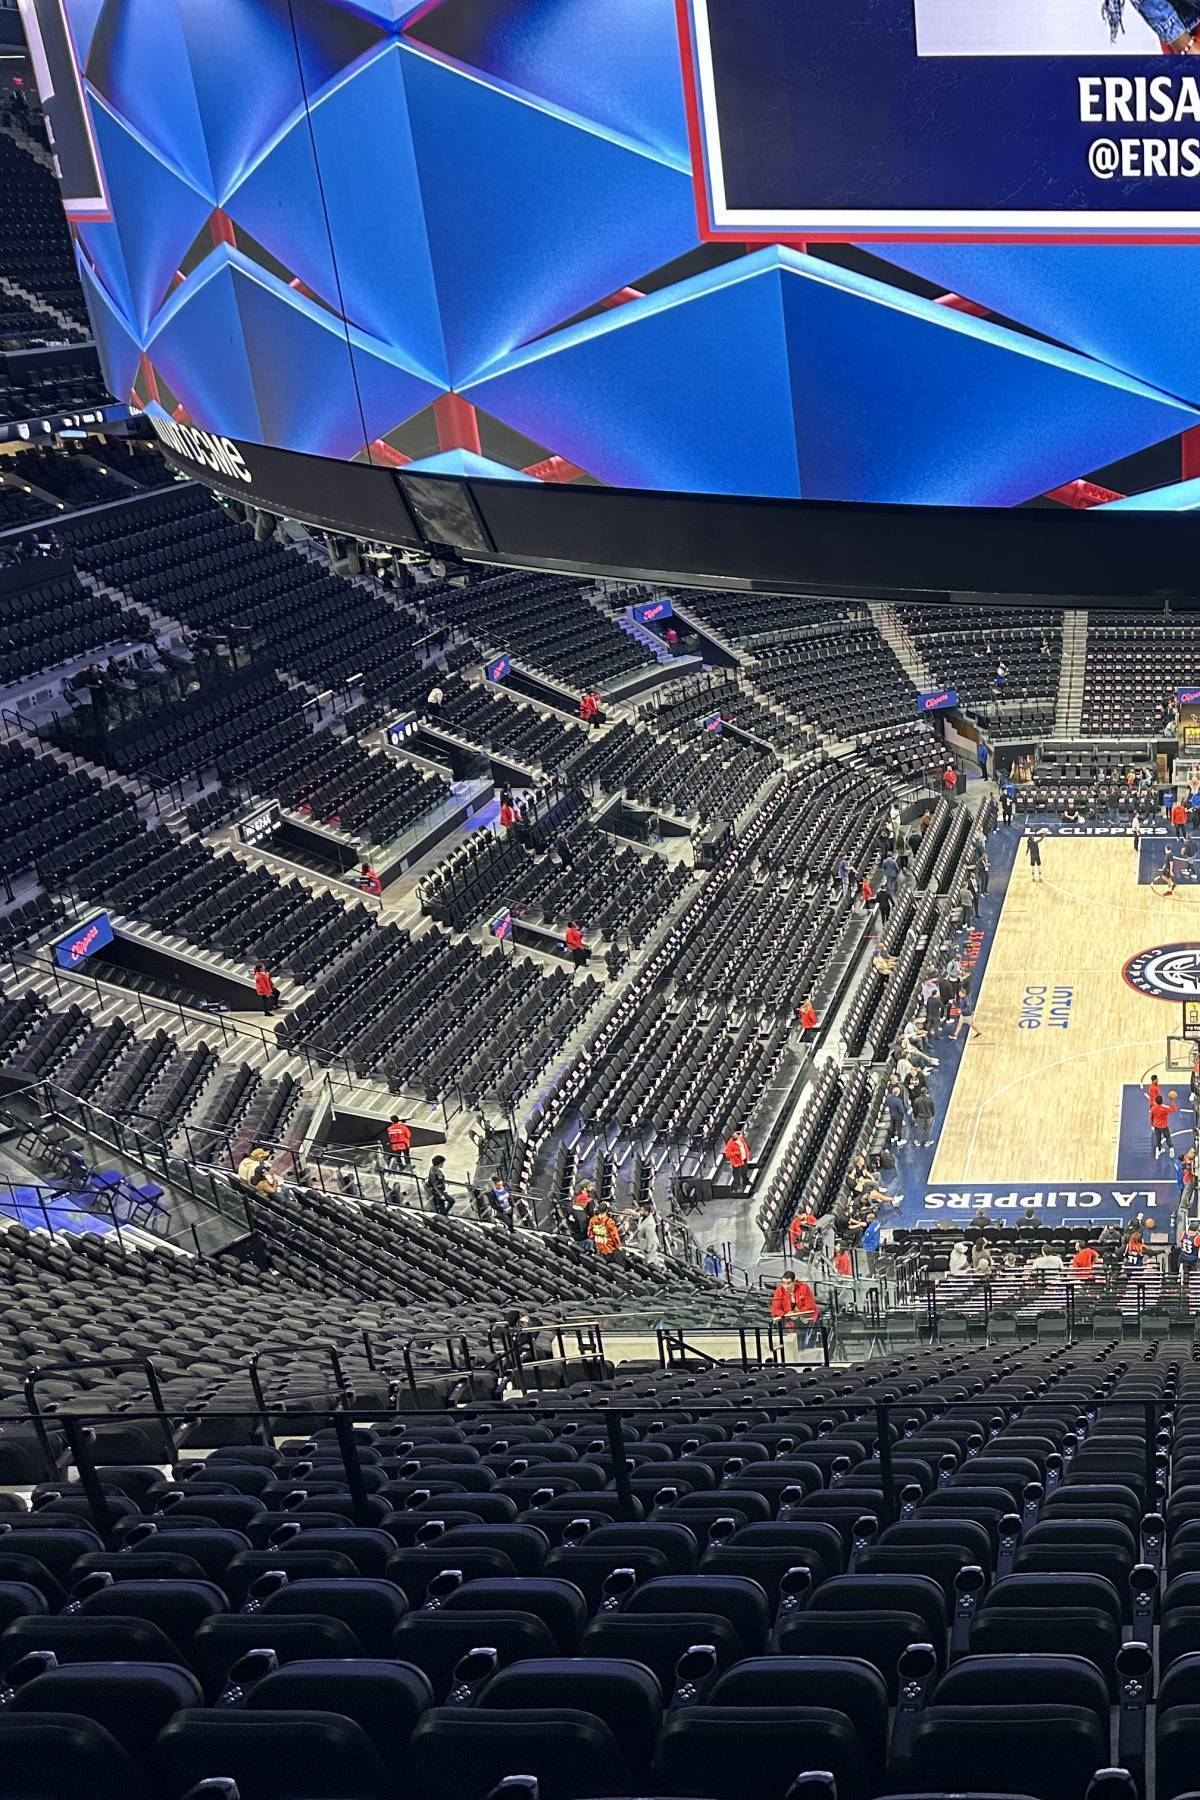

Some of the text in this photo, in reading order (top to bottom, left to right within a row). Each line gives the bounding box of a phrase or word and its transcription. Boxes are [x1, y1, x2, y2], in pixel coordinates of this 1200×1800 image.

[1024, 827, 1168, 835] LA CLIPPERS
[1129, 949, 1163, 996] CLIPPERS
[924, 1191, 1158, 1209] LA CLIPPERS
